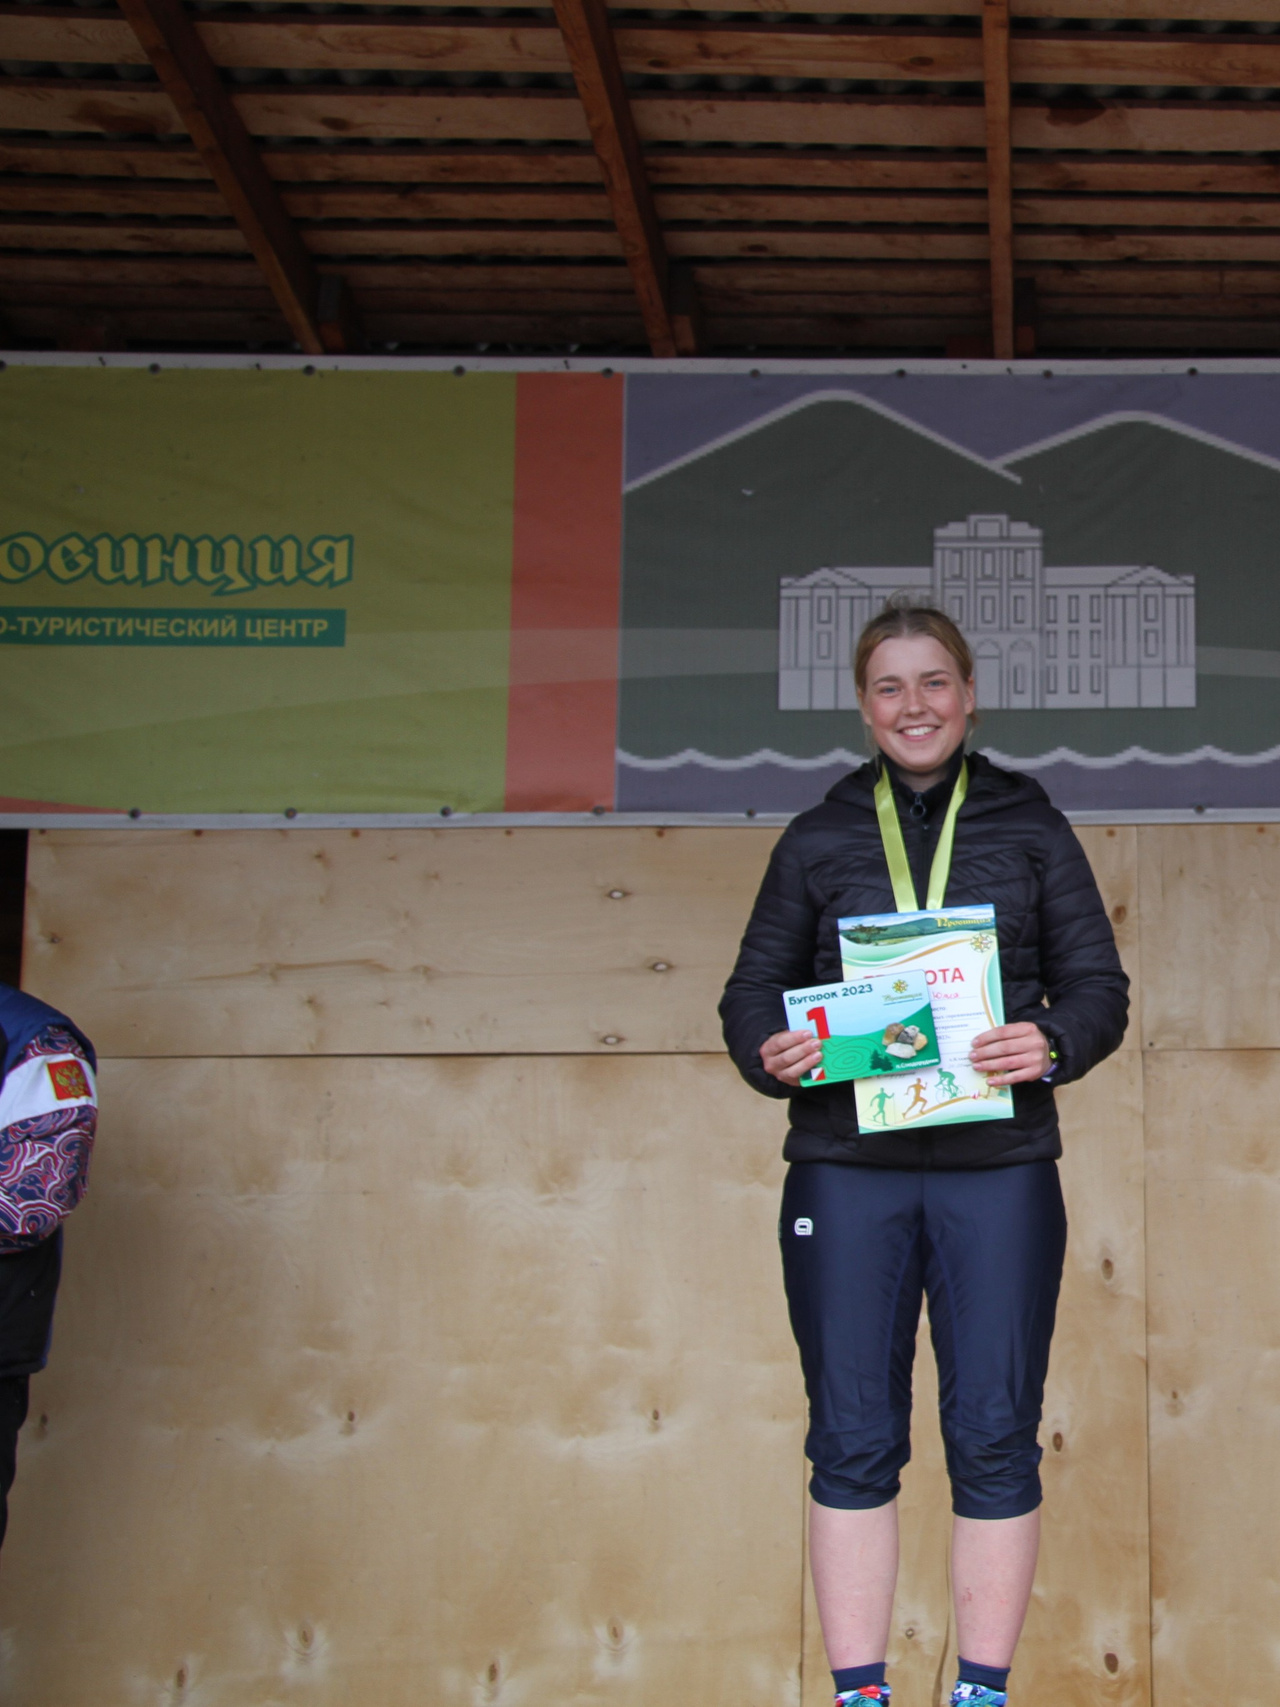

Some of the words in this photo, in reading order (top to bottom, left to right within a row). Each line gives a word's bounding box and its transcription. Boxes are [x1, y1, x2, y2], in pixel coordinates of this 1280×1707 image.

[245, 618, 328, 640] ЦЕНТР
[841, 984, 873, 997] 2023
[806, 1006, 831, 1040] 1
